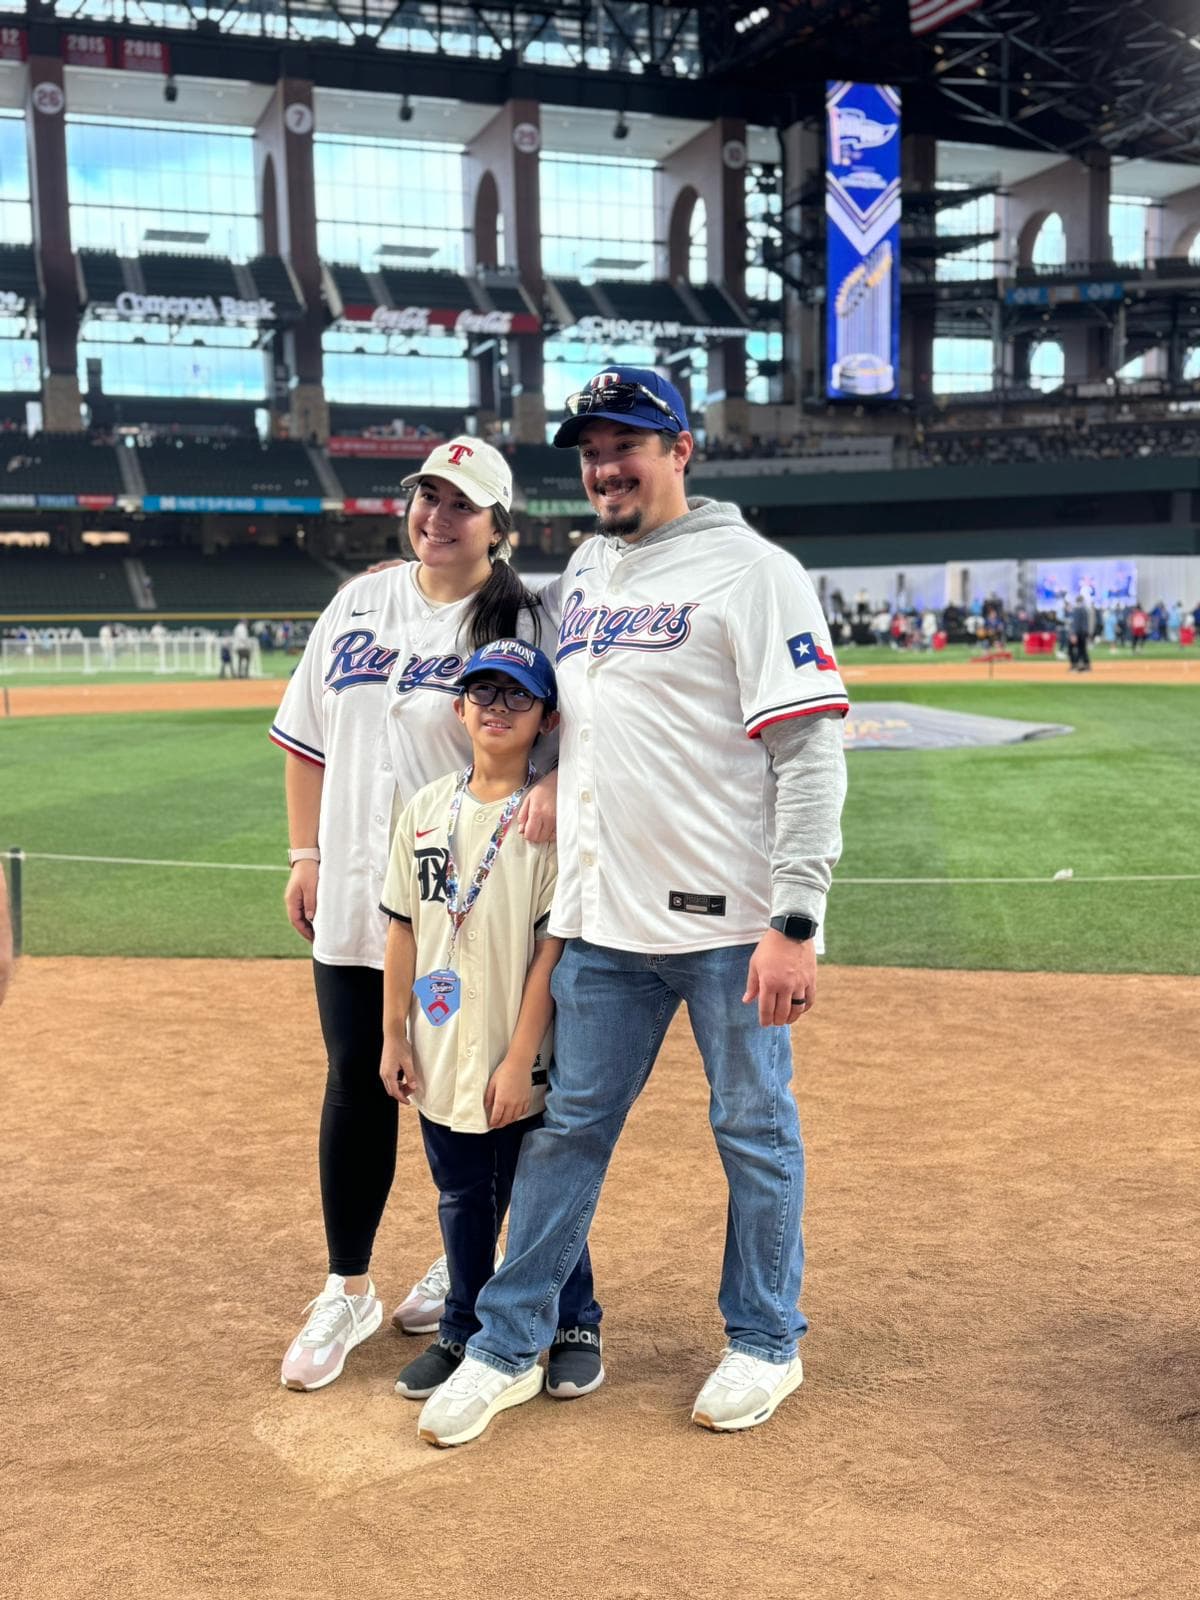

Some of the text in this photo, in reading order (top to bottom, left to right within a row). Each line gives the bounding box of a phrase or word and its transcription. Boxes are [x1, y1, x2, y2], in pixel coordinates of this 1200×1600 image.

[293, 107, 305, 126] 7
[220, 296, 276, 320] Bank
[447, 444, 474, 466] T
[479, 640, 536, 668] CHAMPIONS
